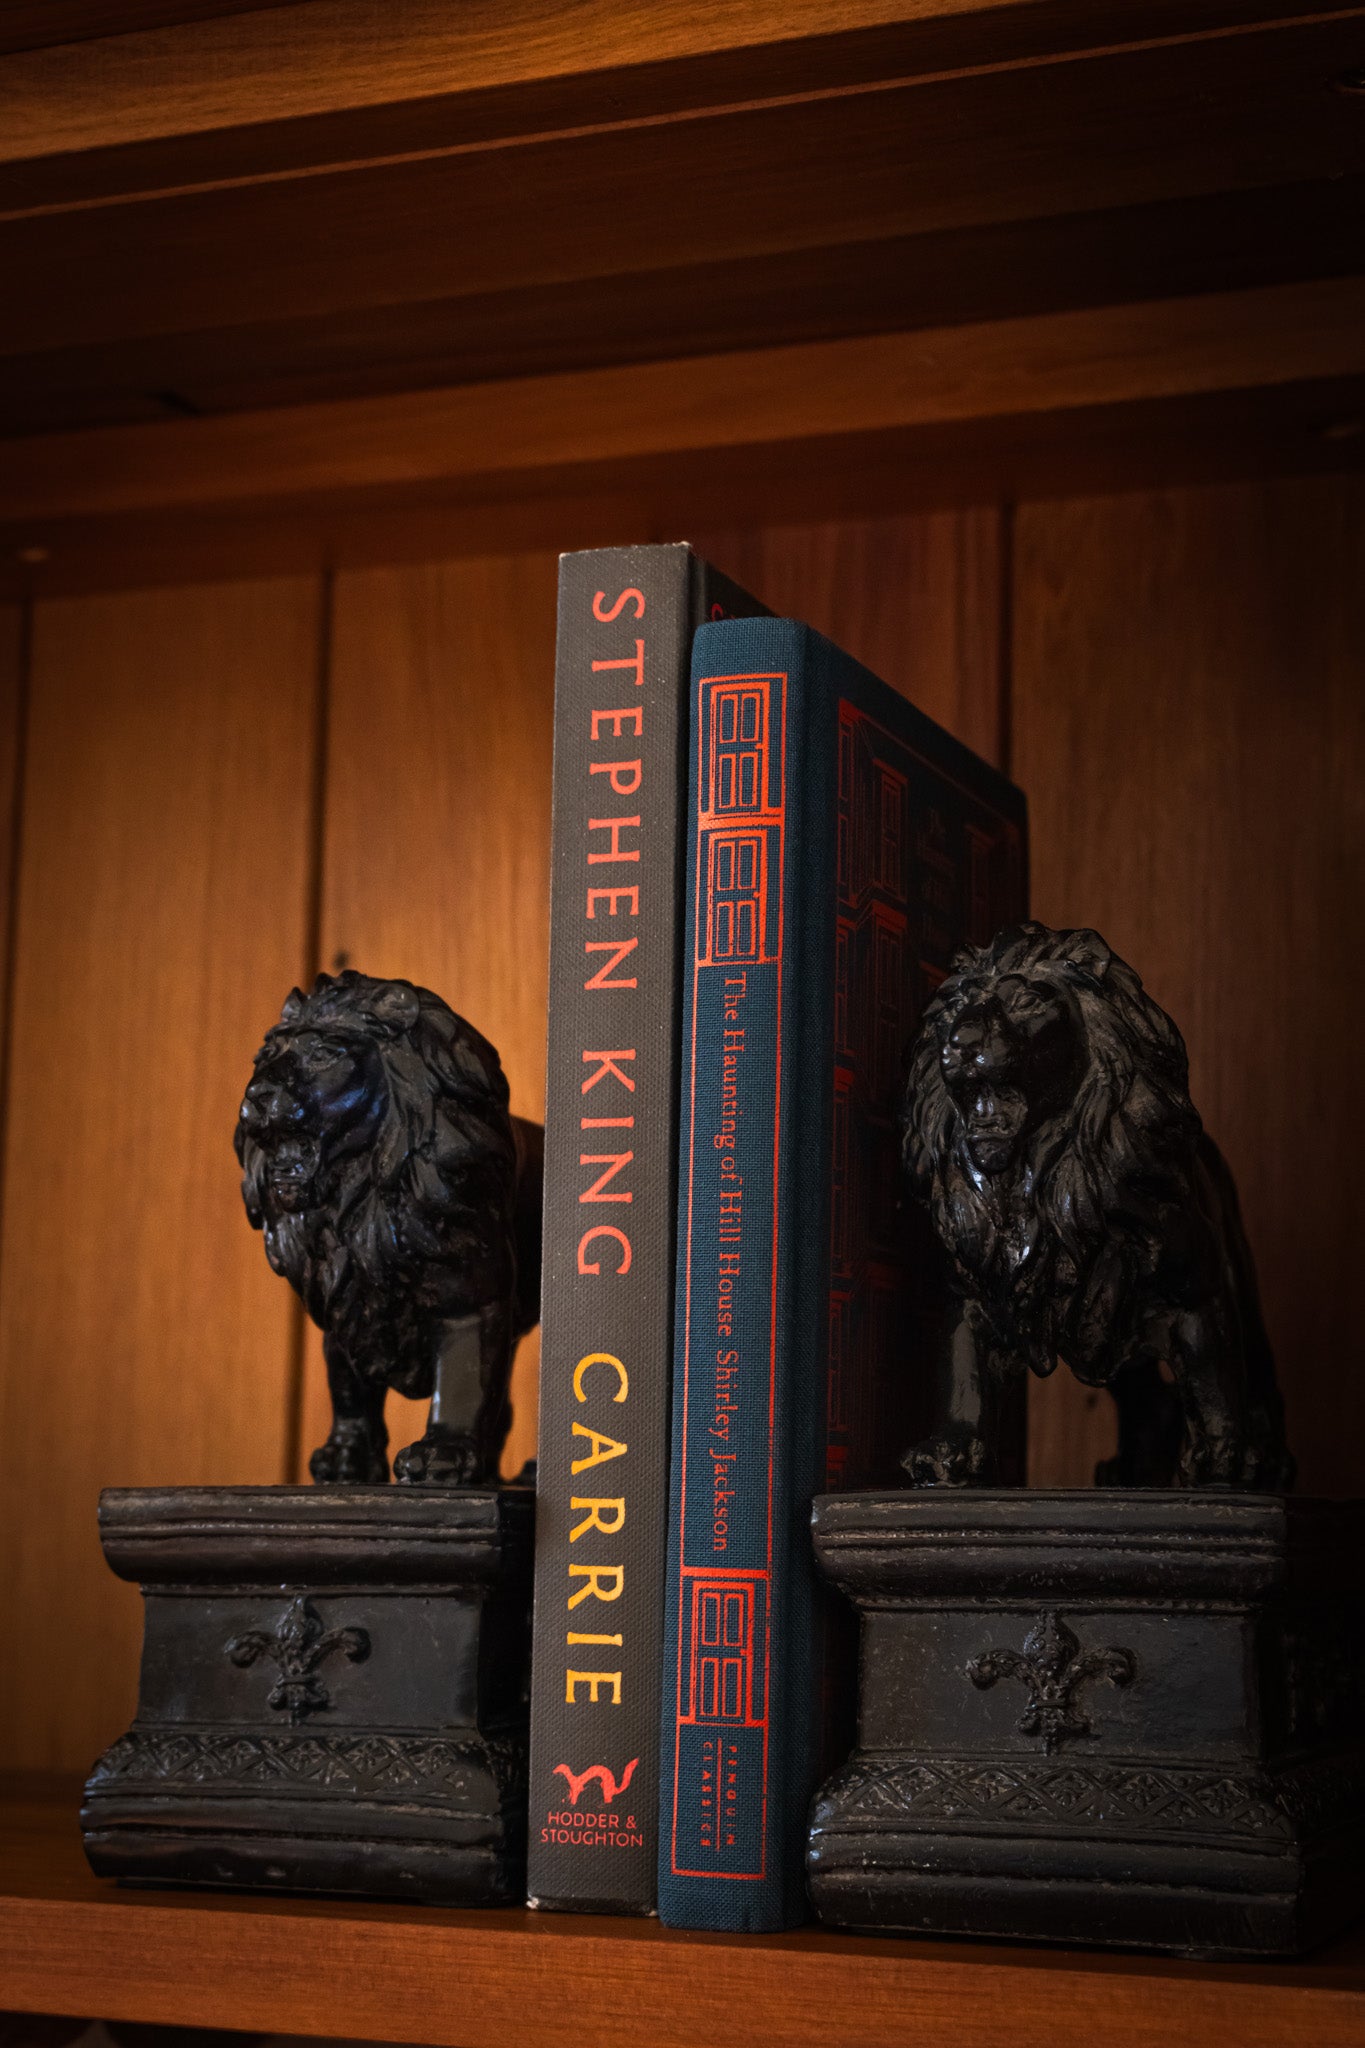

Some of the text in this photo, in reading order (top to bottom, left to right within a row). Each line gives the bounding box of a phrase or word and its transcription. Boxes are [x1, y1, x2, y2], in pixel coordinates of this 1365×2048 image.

[576, 587, 647, 1276] STEPHEN KING
[709, 971, 747, 1551] The Haunting of Hill House Shirley Jackson
[564, 1352, 630, 1706] CARRIE
[540, 1828, 643, 1847] STOUGHTON
[547, 1811, 637, 1829] HODDER &
[701, 1741, 713, 1847] CLASSICS
[726, 1745, 738, 1846] PENGUIN
